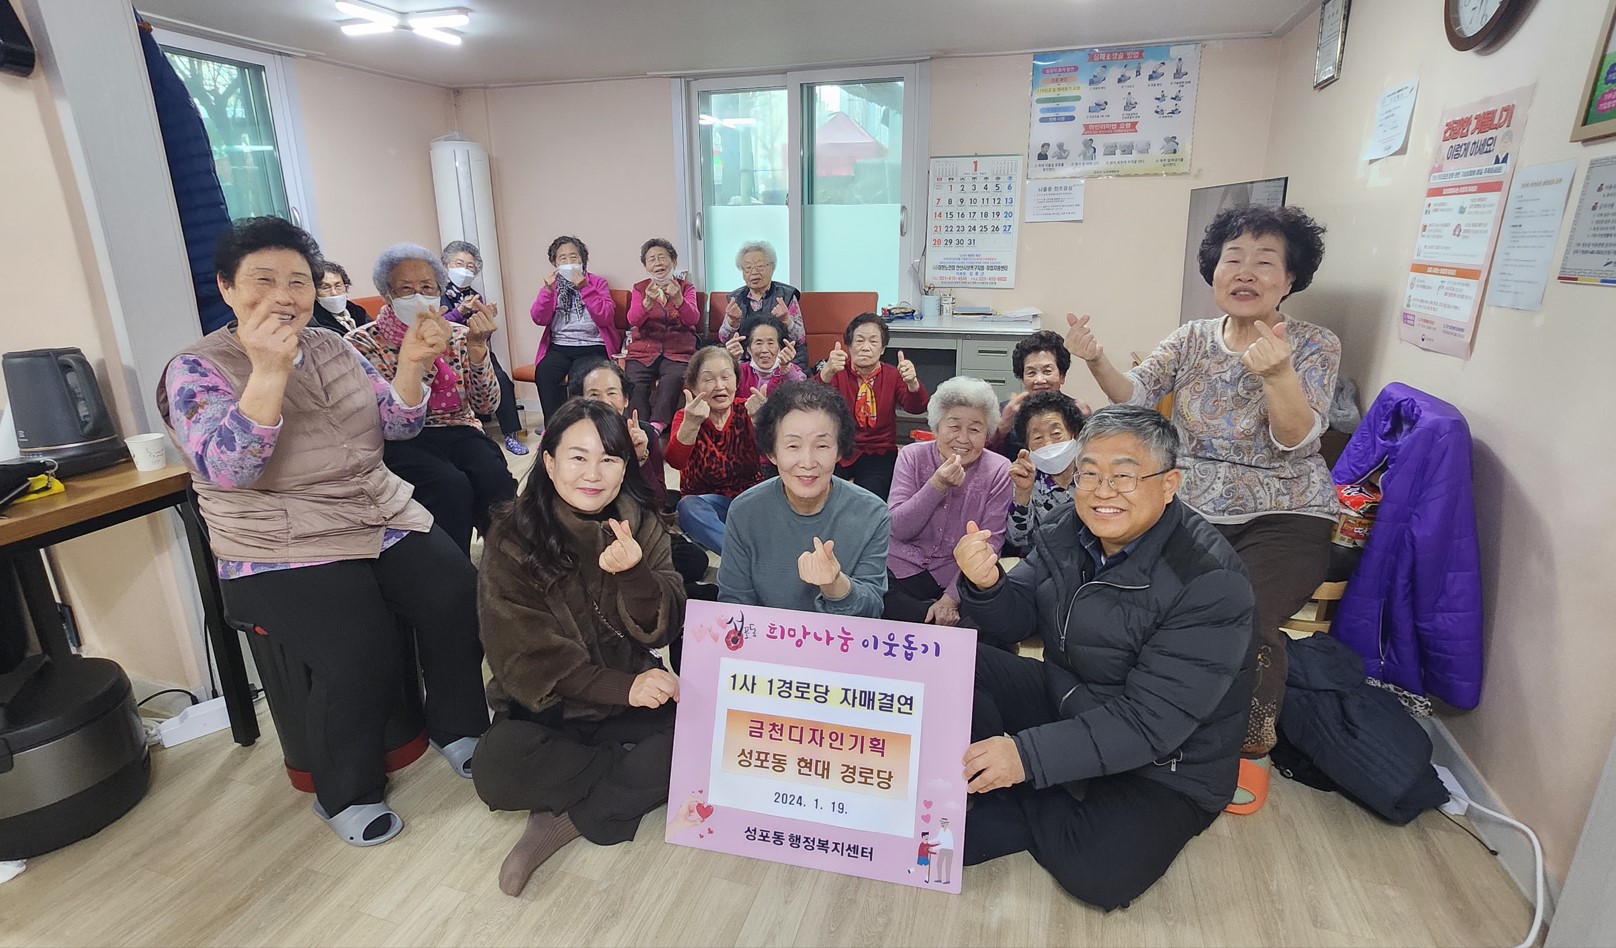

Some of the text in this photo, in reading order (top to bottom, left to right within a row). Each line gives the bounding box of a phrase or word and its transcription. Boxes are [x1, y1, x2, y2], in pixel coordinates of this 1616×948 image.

[1442, 114, 1473, 142] 건강한
[1471, 103, 1515, 135] 겨울나기
[973, 161, 978, 172] 1
[1446, 136, 1497, 160] 이렇게 하세요!
[765, 622, 855, 652] 희망나눔
[861, 632, 941, 661] 이웃돕기
[730, 673, 915, 716] 1사 1경로당 자매결연
[747, 719, 887, 758] 금천디자인기획
[736, 748, 894, 790] 성포동 현대 경로당
[773, 791, 848, 815] 2024. 1. 19.
[743, 825, 875, 862] 성포동 행정복지센터
